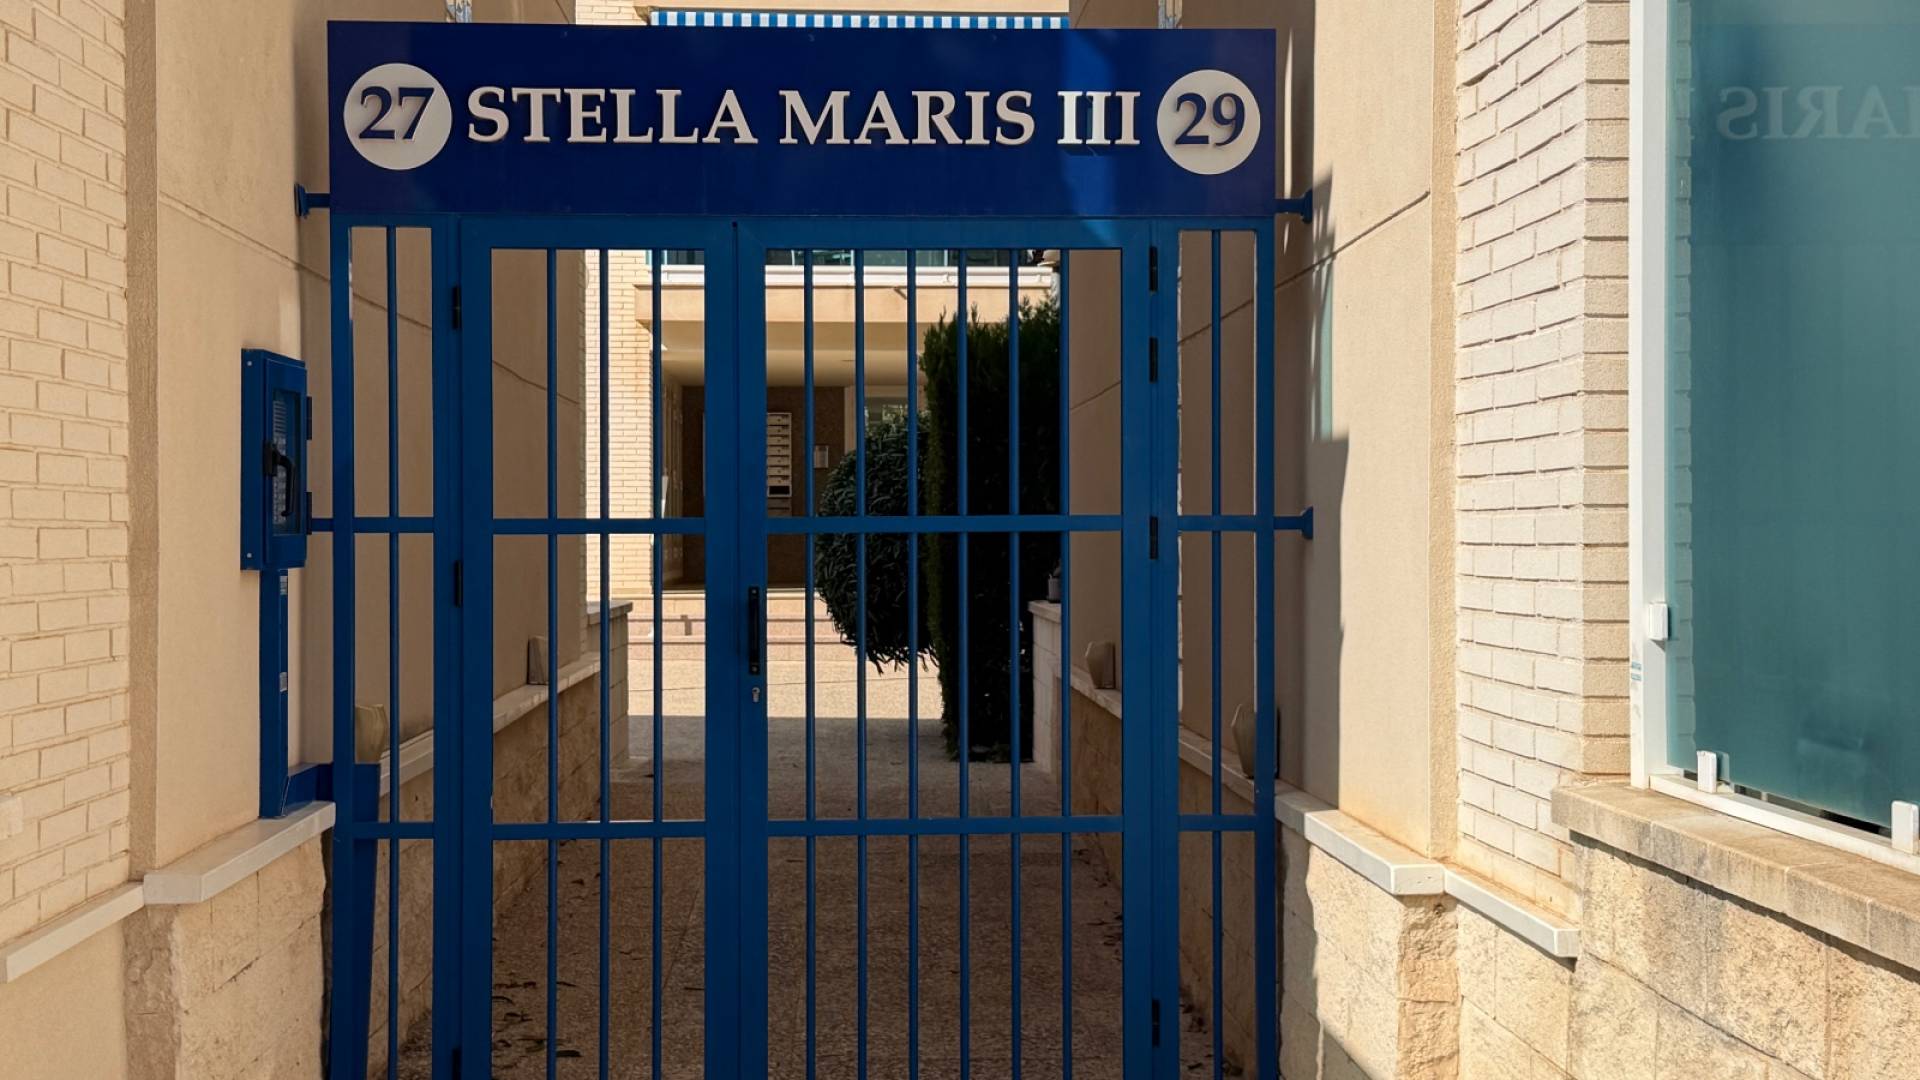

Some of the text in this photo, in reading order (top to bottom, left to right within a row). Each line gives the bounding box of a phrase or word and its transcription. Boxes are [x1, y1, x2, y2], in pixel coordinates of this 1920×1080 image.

[358, 85, 1246, 148] 27 STELLA MARIS III 29
